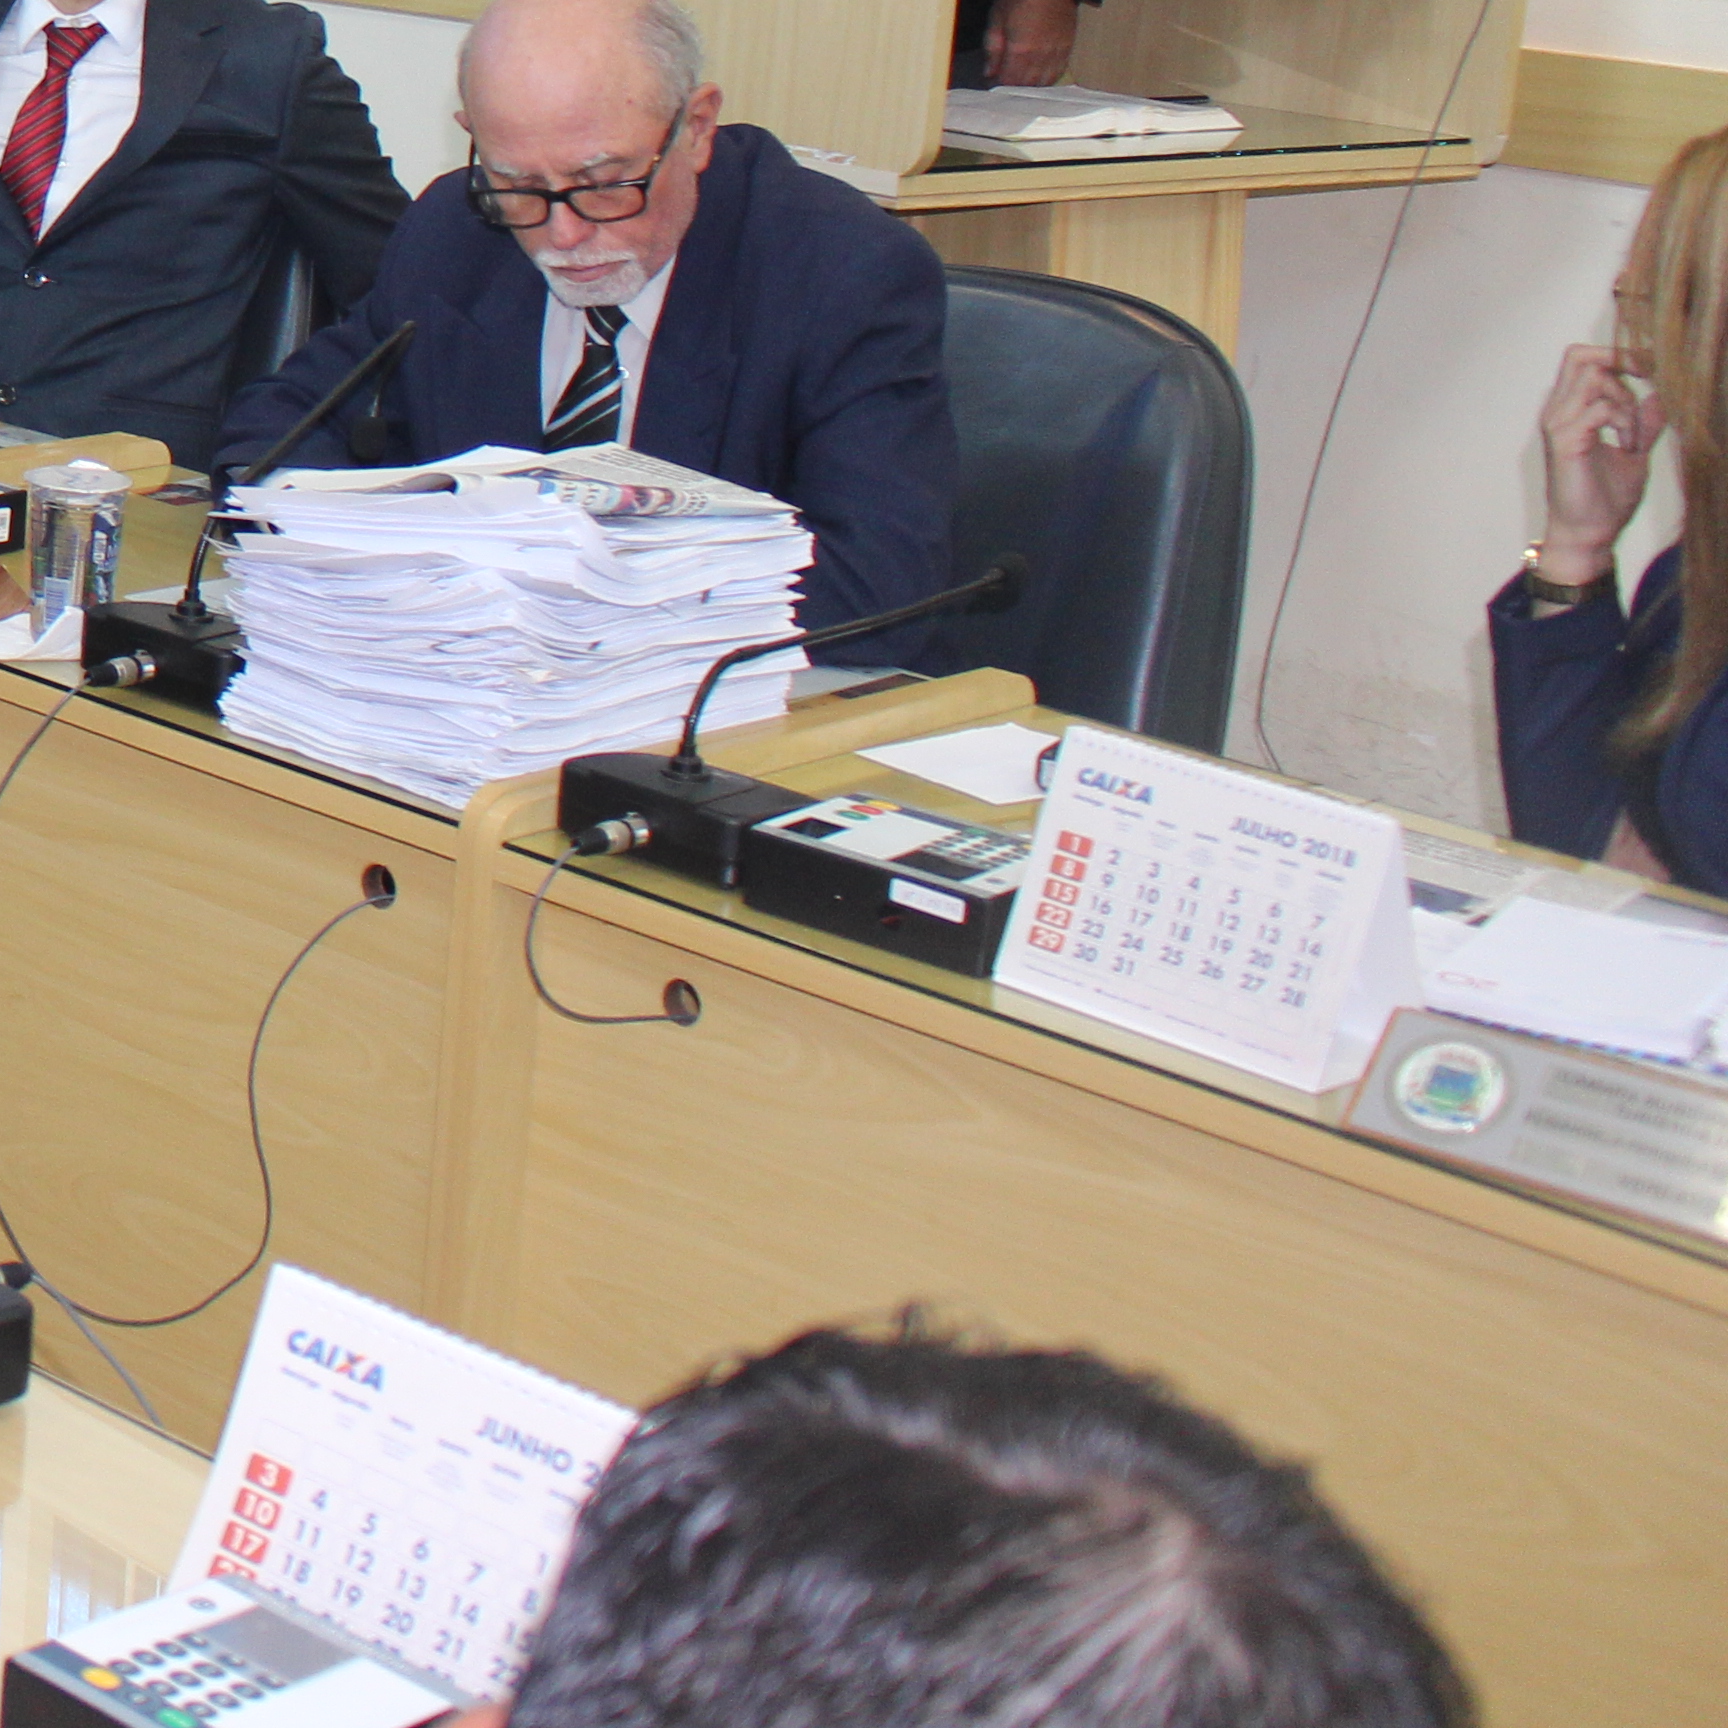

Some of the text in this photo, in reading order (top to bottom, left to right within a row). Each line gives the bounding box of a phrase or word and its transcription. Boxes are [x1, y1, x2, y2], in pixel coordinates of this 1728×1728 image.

[1078, 768, 1358, 869] CAIXA JULHO 2018
[1053, 881, 1074, 901] 15
[1062, 860, 1077, 877] 8
[1107, 849, 1122, 866] 2
[1147, 862, 1163, 878] 3
[1187, 876, 1202, 891] 4
[1227, 888, 1242, 906] 5
[1267, 902, 1283, 919] 6
[1310, 914, 1326, 930] 7
[1036, 929, 1061, 951] 29
[1044, 905, 1068, 926] 22
[286, 1329, 575, 1474] CAIXA JUNHO
[245, 1491, 481, 1625] 10 11 12 13 14
[258, 1460, 279, 1487] 3
[311, 1489, 330, 1510] 4
[360, 1512, 378, 1536] 5
[413, 1537, 431, 1561] 6
[466, 1560, 486, 1584] 7
[229, 1523, 262, 1559] 17
[332, 1577, 363, 1607] 19
[381, 1603, 415, 1636] 20
[434, 1629, 467, 1661] 21
